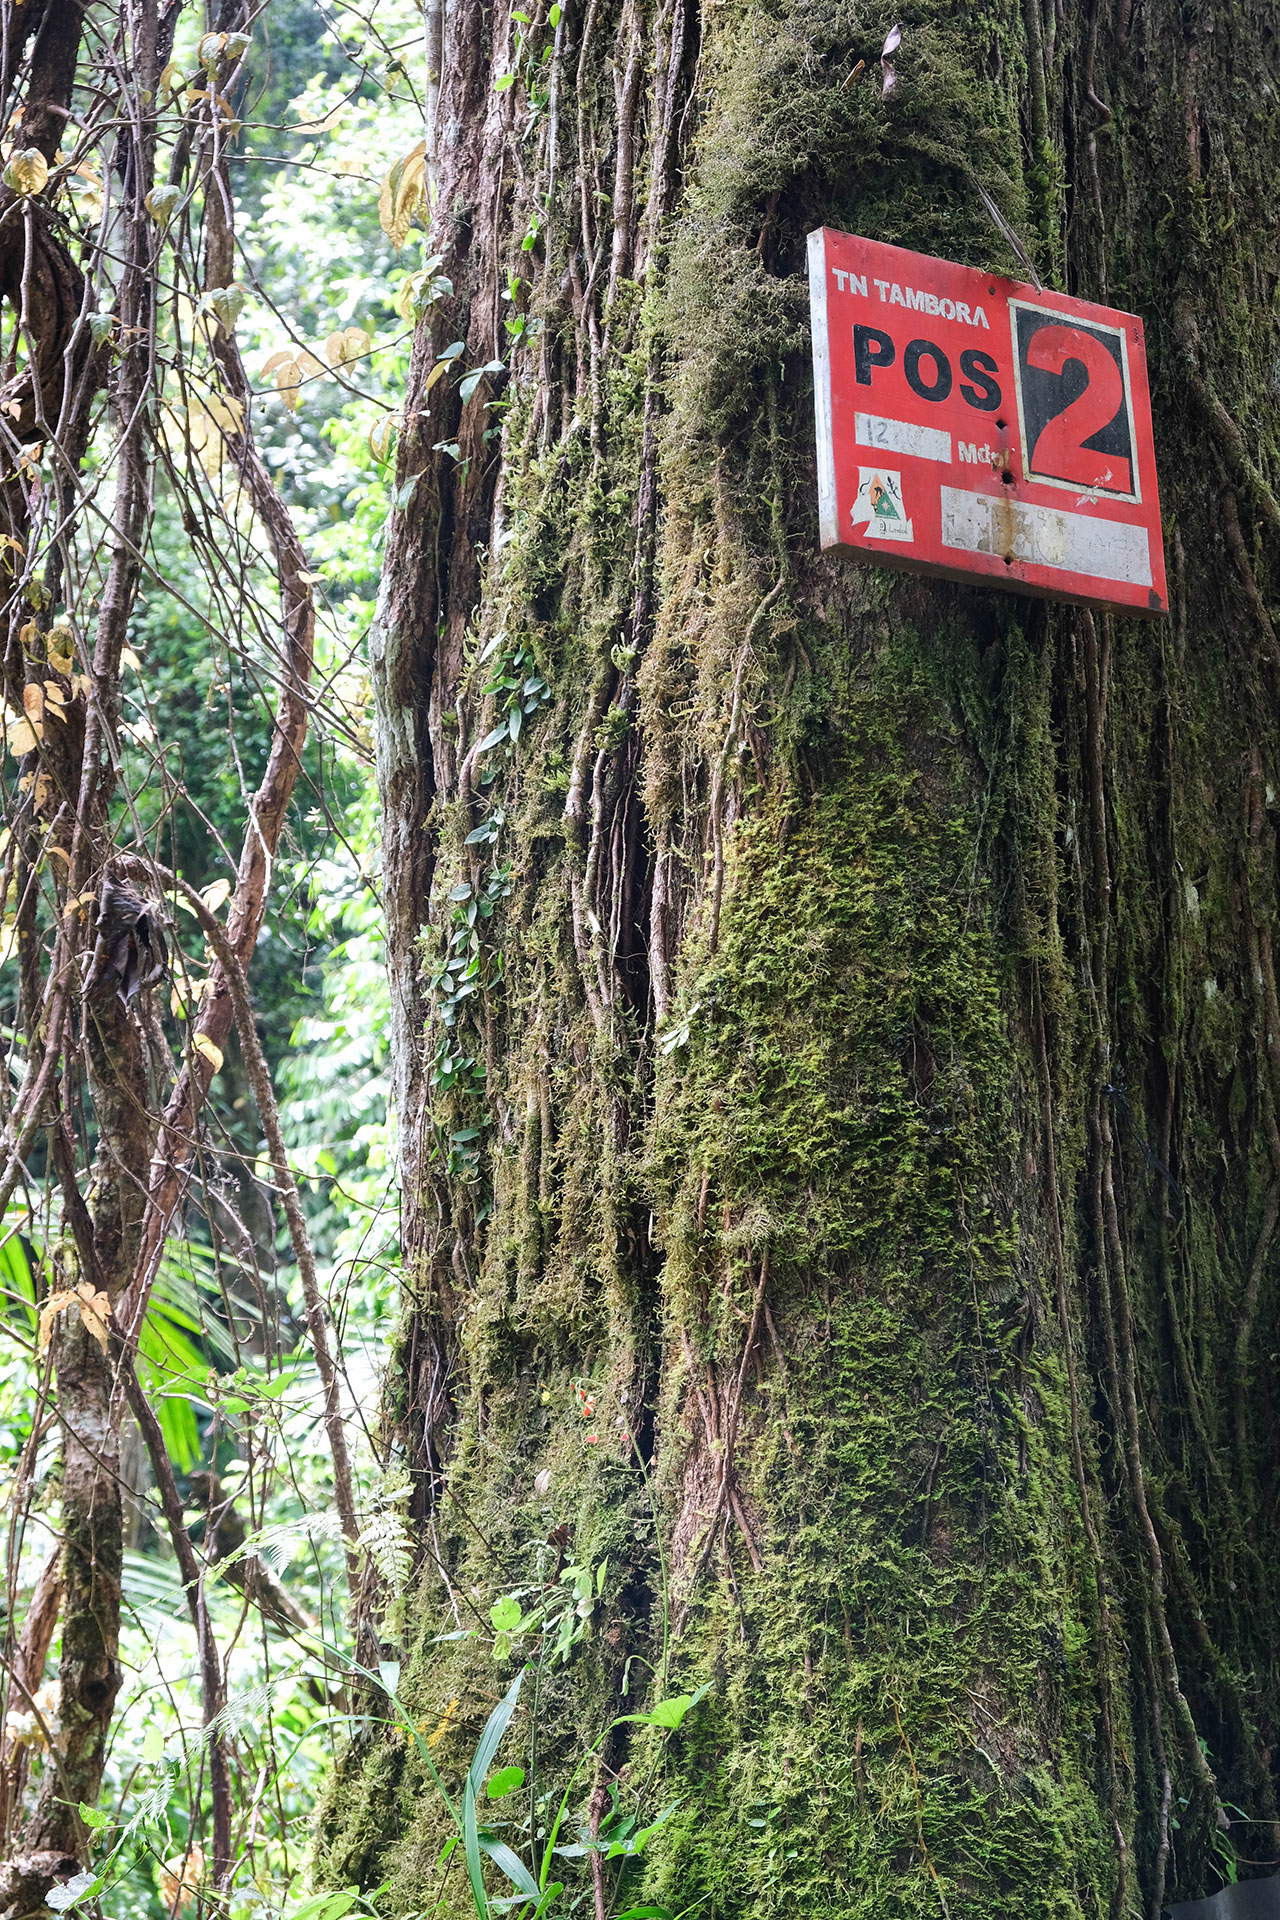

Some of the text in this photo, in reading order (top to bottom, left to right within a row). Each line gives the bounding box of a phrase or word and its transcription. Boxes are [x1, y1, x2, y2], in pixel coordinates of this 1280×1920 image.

[832, 268, 990, 330] TN TAMBORA
[852, 323, 1132, 493] POS 2
